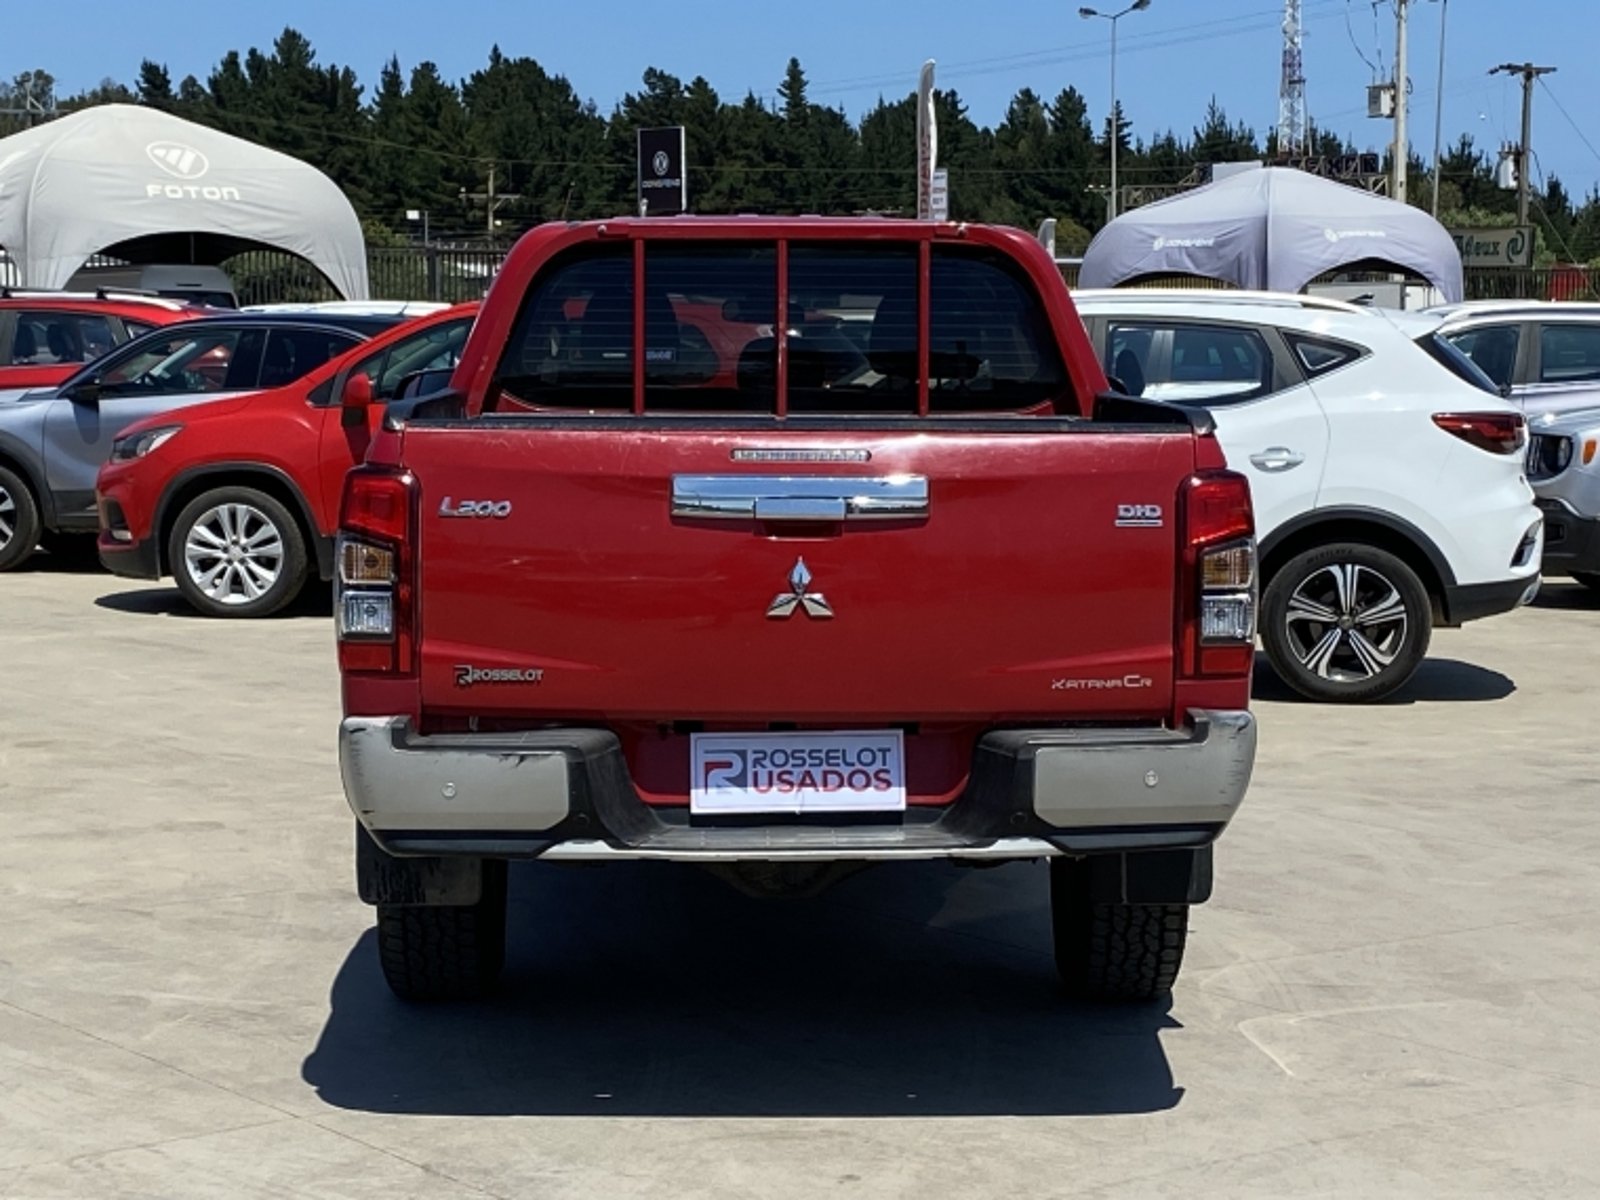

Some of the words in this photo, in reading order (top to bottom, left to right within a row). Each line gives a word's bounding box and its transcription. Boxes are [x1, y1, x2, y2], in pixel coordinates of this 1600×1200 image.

[146, 184, 240, 200] FOTON
[439, 496, 512, 517] L200
[473, 668, 545, 681] ROSSELOT
[752, 747, 891, 768] ROSSELOT
[752, 768, 893, 793] USADOS
